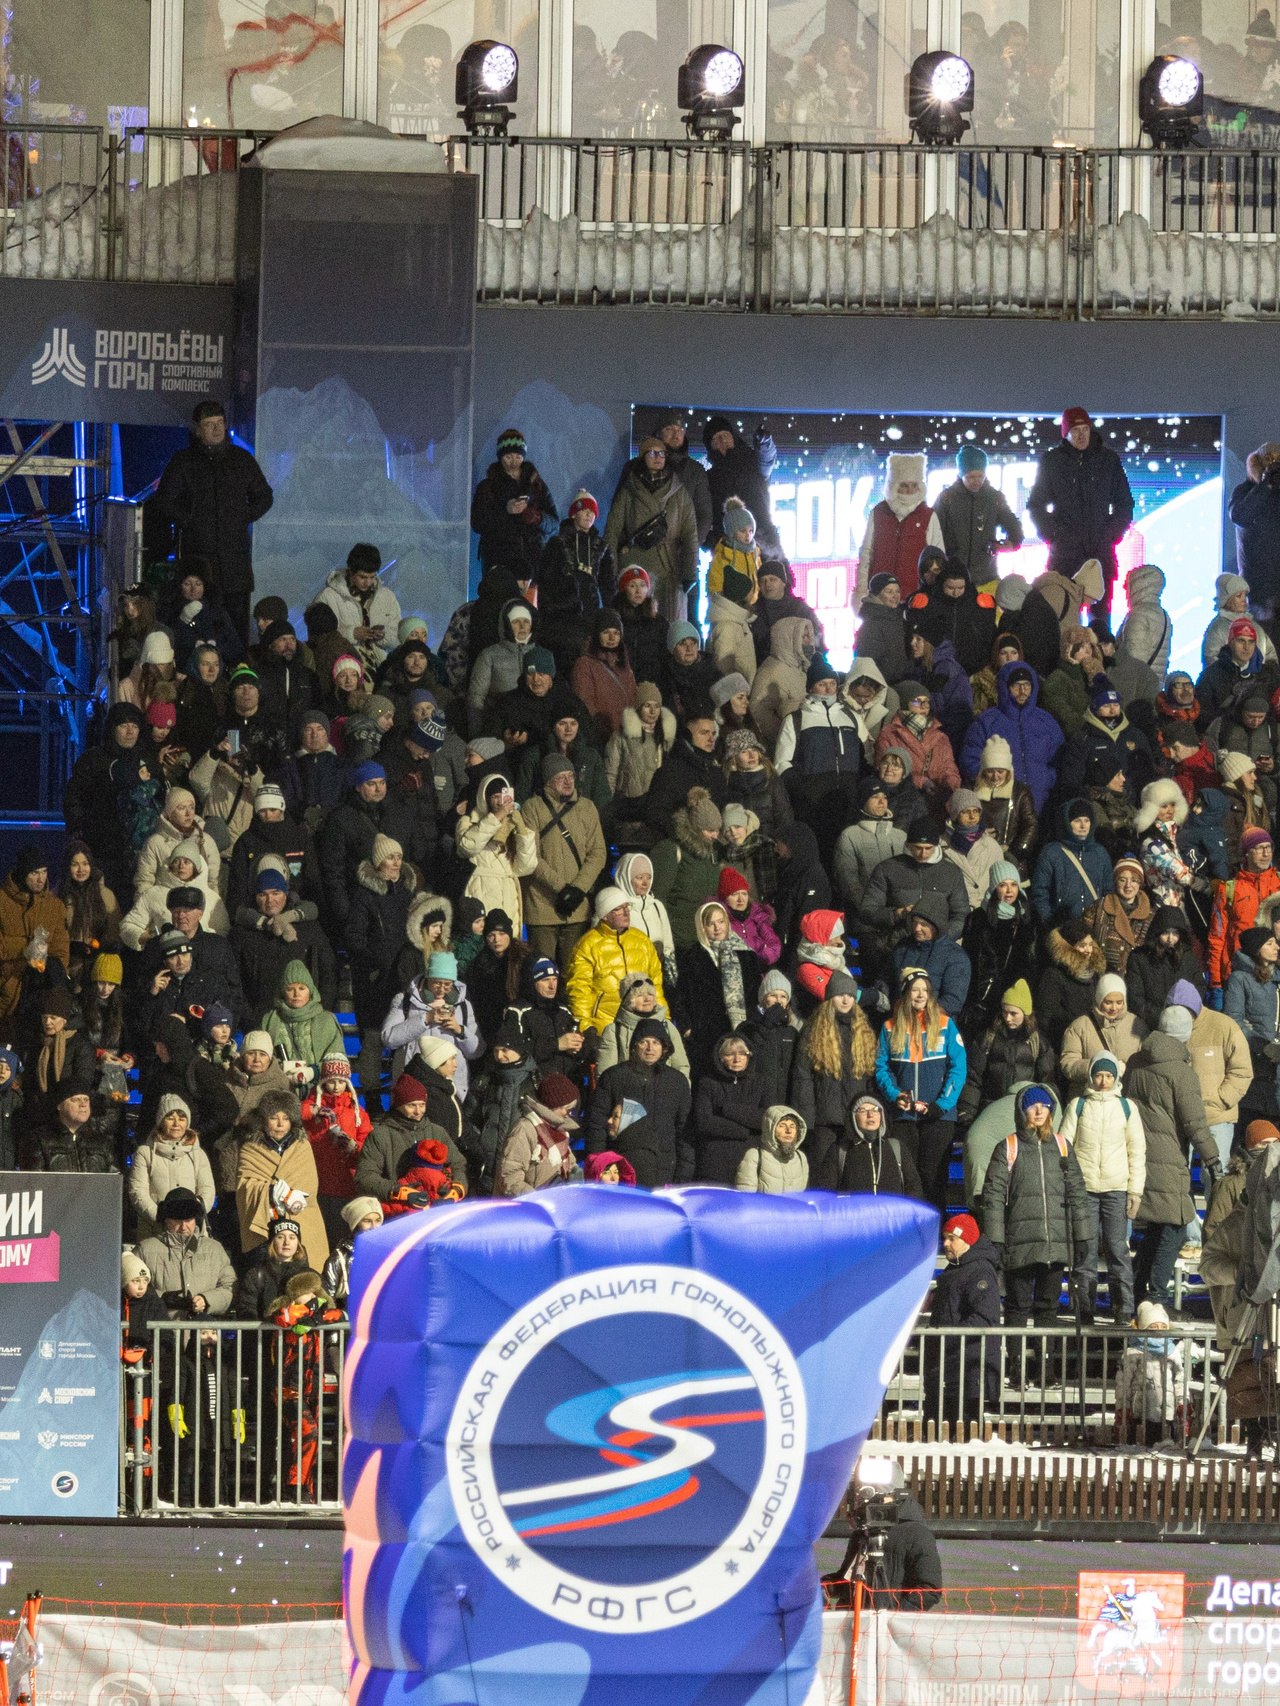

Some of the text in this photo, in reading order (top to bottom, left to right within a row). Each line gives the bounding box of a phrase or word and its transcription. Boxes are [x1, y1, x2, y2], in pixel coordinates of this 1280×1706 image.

[95, 330, 224, 363] ВОРОБЬЁВЫ
[94, 361, 155, 391] ГОРЫ
[161, 379, 210, 392] КОМПЛЕКС
[162, 364, 223, 379] СПОРТИВНЫЙ
[456, 1278, 796, 1554] РОССИЙСКАЯ ФЕДЕРАЦИЯ ГОРНОЛЫЖНОГО СПОРТА
[552, 1582, 697, 1622] РФГС
